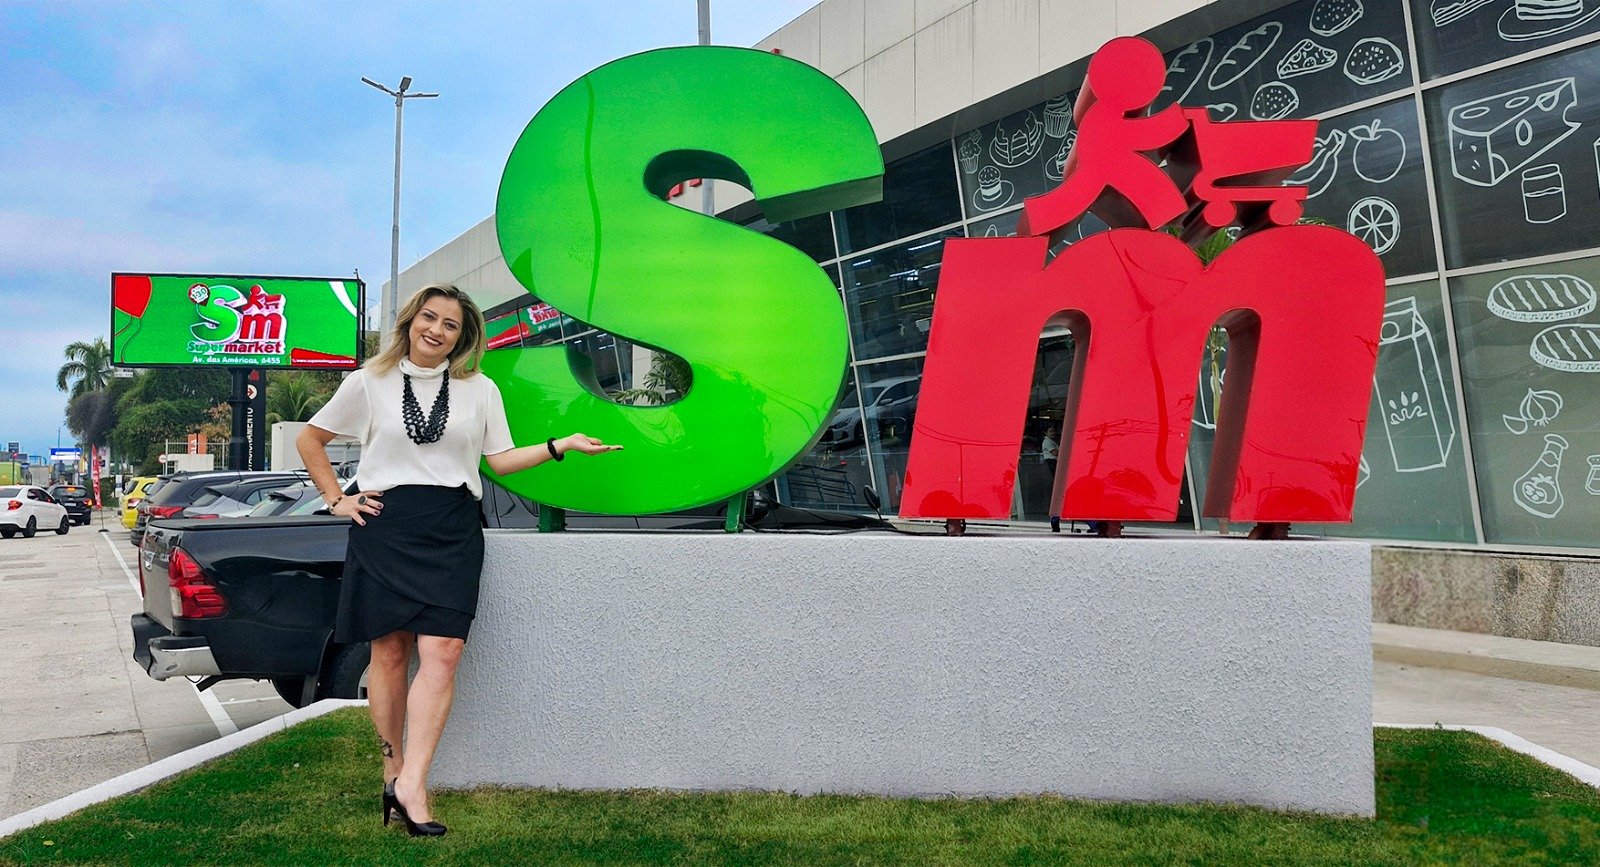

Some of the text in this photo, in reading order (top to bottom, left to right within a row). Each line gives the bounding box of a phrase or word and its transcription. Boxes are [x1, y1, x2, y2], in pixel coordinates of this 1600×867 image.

[187, 341, 282, 354] Supermarket
[192, 355, 205, 363] Av.
[207, 355, 220, 363] das
[222, 355, 259, 365] Américas,
